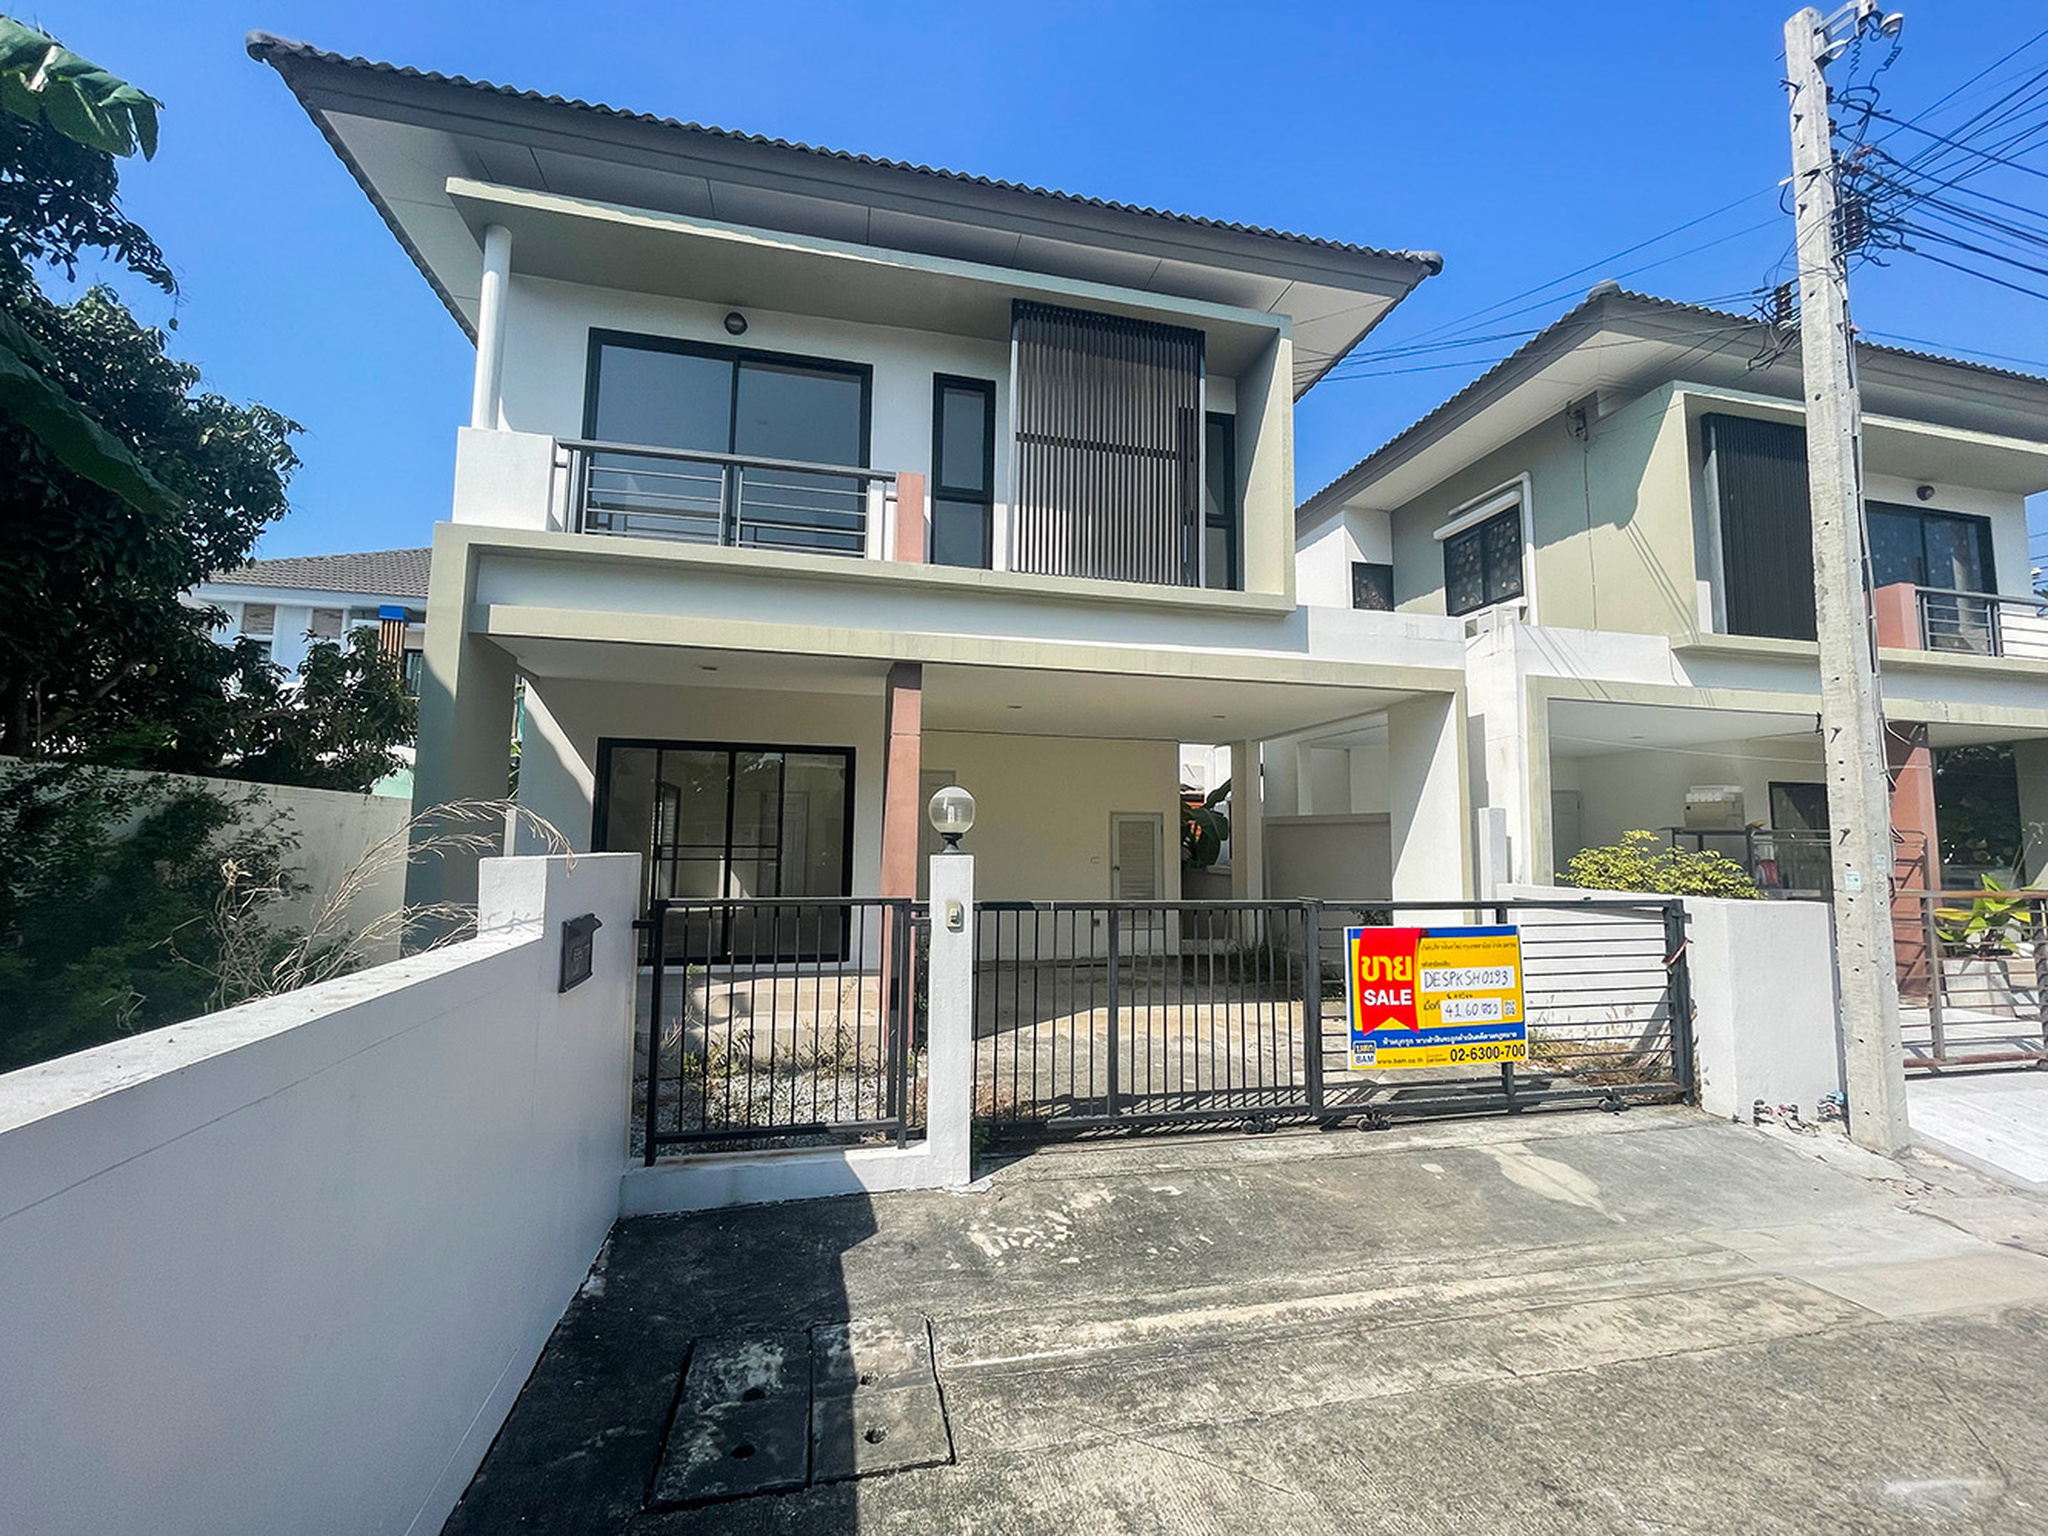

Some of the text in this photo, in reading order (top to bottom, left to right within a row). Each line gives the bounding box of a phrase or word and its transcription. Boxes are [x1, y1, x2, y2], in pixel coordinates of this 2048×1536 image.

[1361, 956, 1412, 982] ขาย
[1424, 968, 1509, 989] DESPKSH0193
[1363, 989, 1412, 1006] SALE
[1355, 1055, 1374, 1064] BAM
[1450, 1044, 1526, 1062] 02-6300-700
